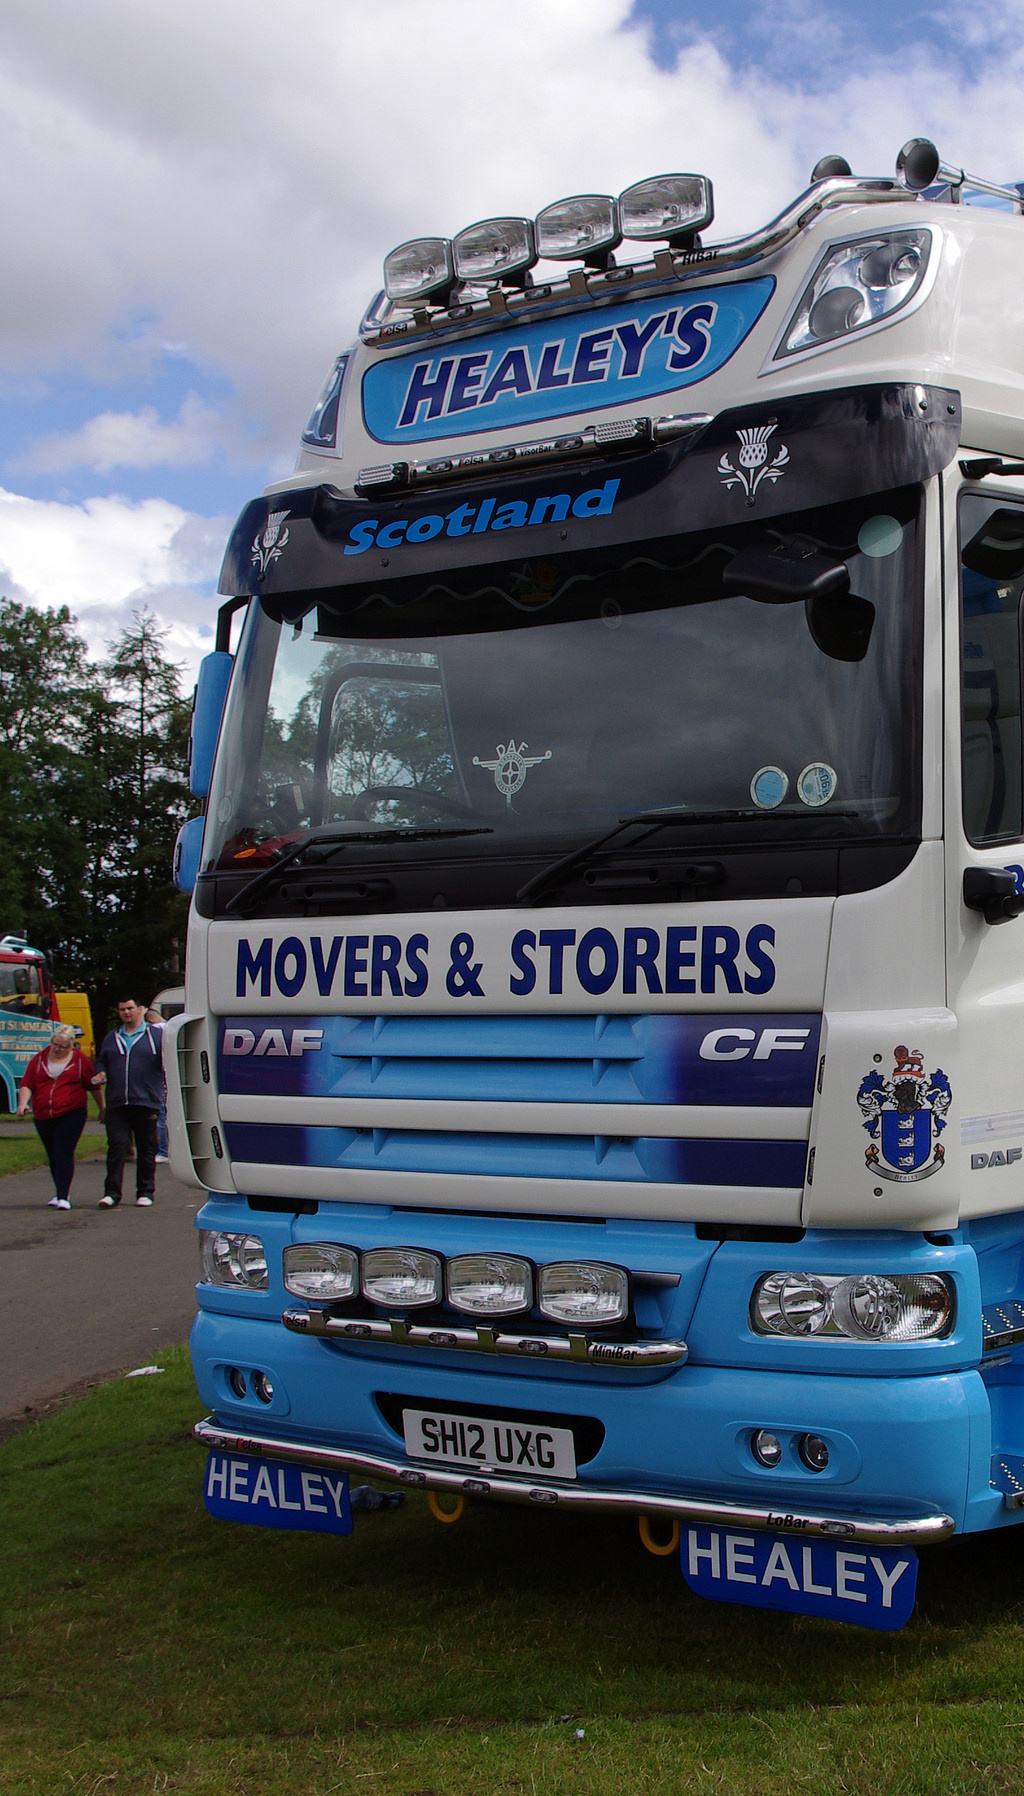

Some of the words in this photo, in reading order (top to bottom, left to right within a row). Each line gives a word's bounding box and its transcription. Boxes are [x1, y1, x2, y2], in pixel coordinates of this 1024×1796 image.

[394, 301, 720, 430] HEALEY'S
[343, 478, 621, 556] Scotland
[236, 933, 430, 998] MOVERS
[446, 932, 486, 998] &
[509, 923, 777, 996] STORERS
[222, 1028, 323, 1057] DAF
[698, 1027, 812, 1062] CF
[971, 1147, 1023, 1170] DAF
[421, 1417, 486, 1460] SH12
[494, 1427, 556, 1469] UXG
[206, 1457, 344, 1519] HEALEY
[766, 1512, 810, 1529] LoBar
[688, 1529, 910, 1609] HEALEY
